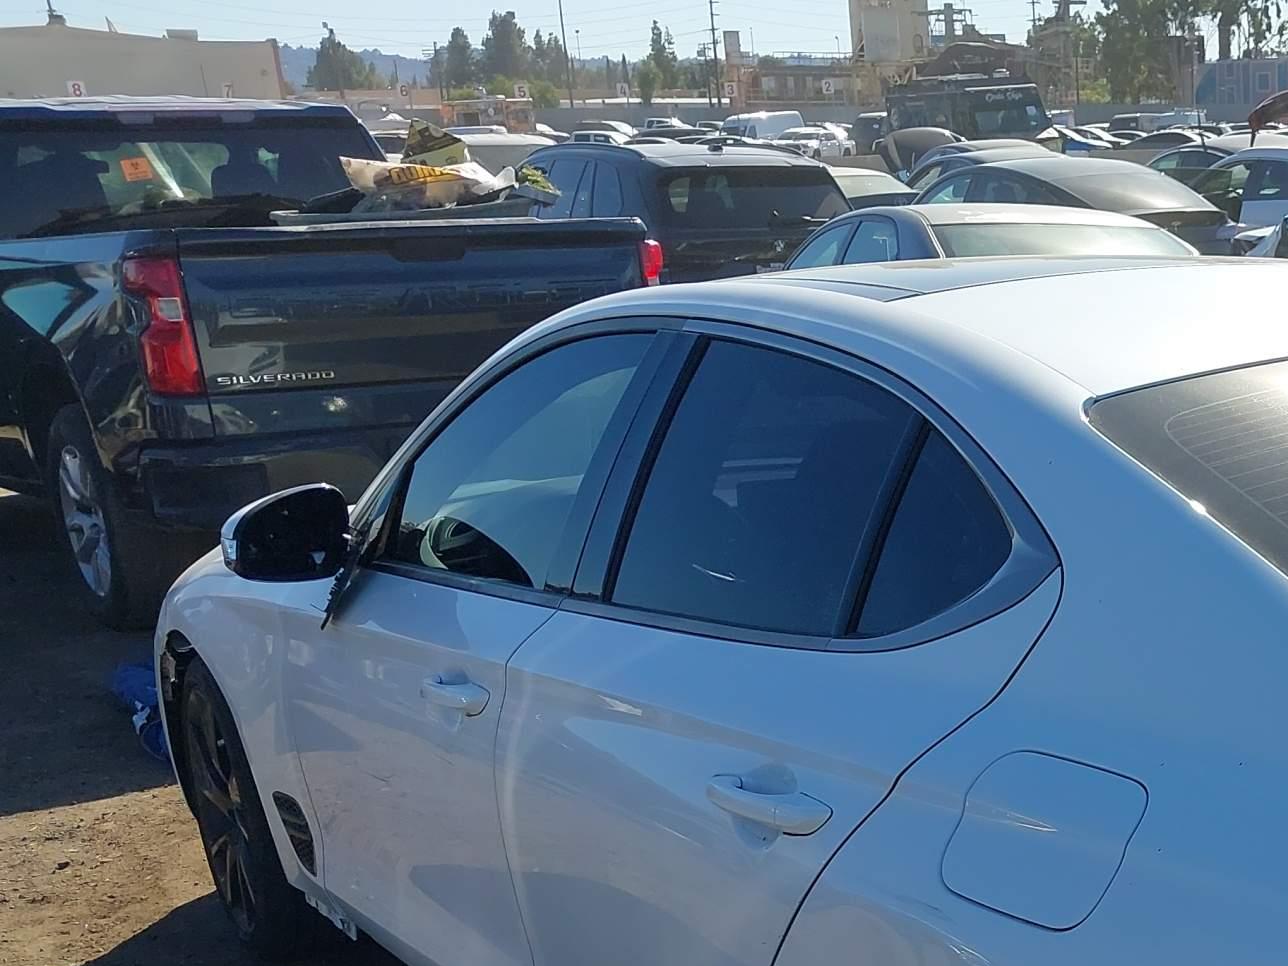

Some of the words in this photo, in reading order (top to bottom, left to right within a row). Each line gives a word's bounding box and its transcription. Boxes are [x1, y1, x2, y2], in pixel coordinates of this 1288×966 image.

[72, 83, 82, 97] 8
[223, 84, 233, 98] 7
[400, 85, 408, 97] 6
[517, 86, 526, 98] 5
[619, 84, 627, 98] 4
[727, 84, 735, 96] 3
[824, 81, 832, 93] 2
[216, 370, 336, 386] SILVERADO
